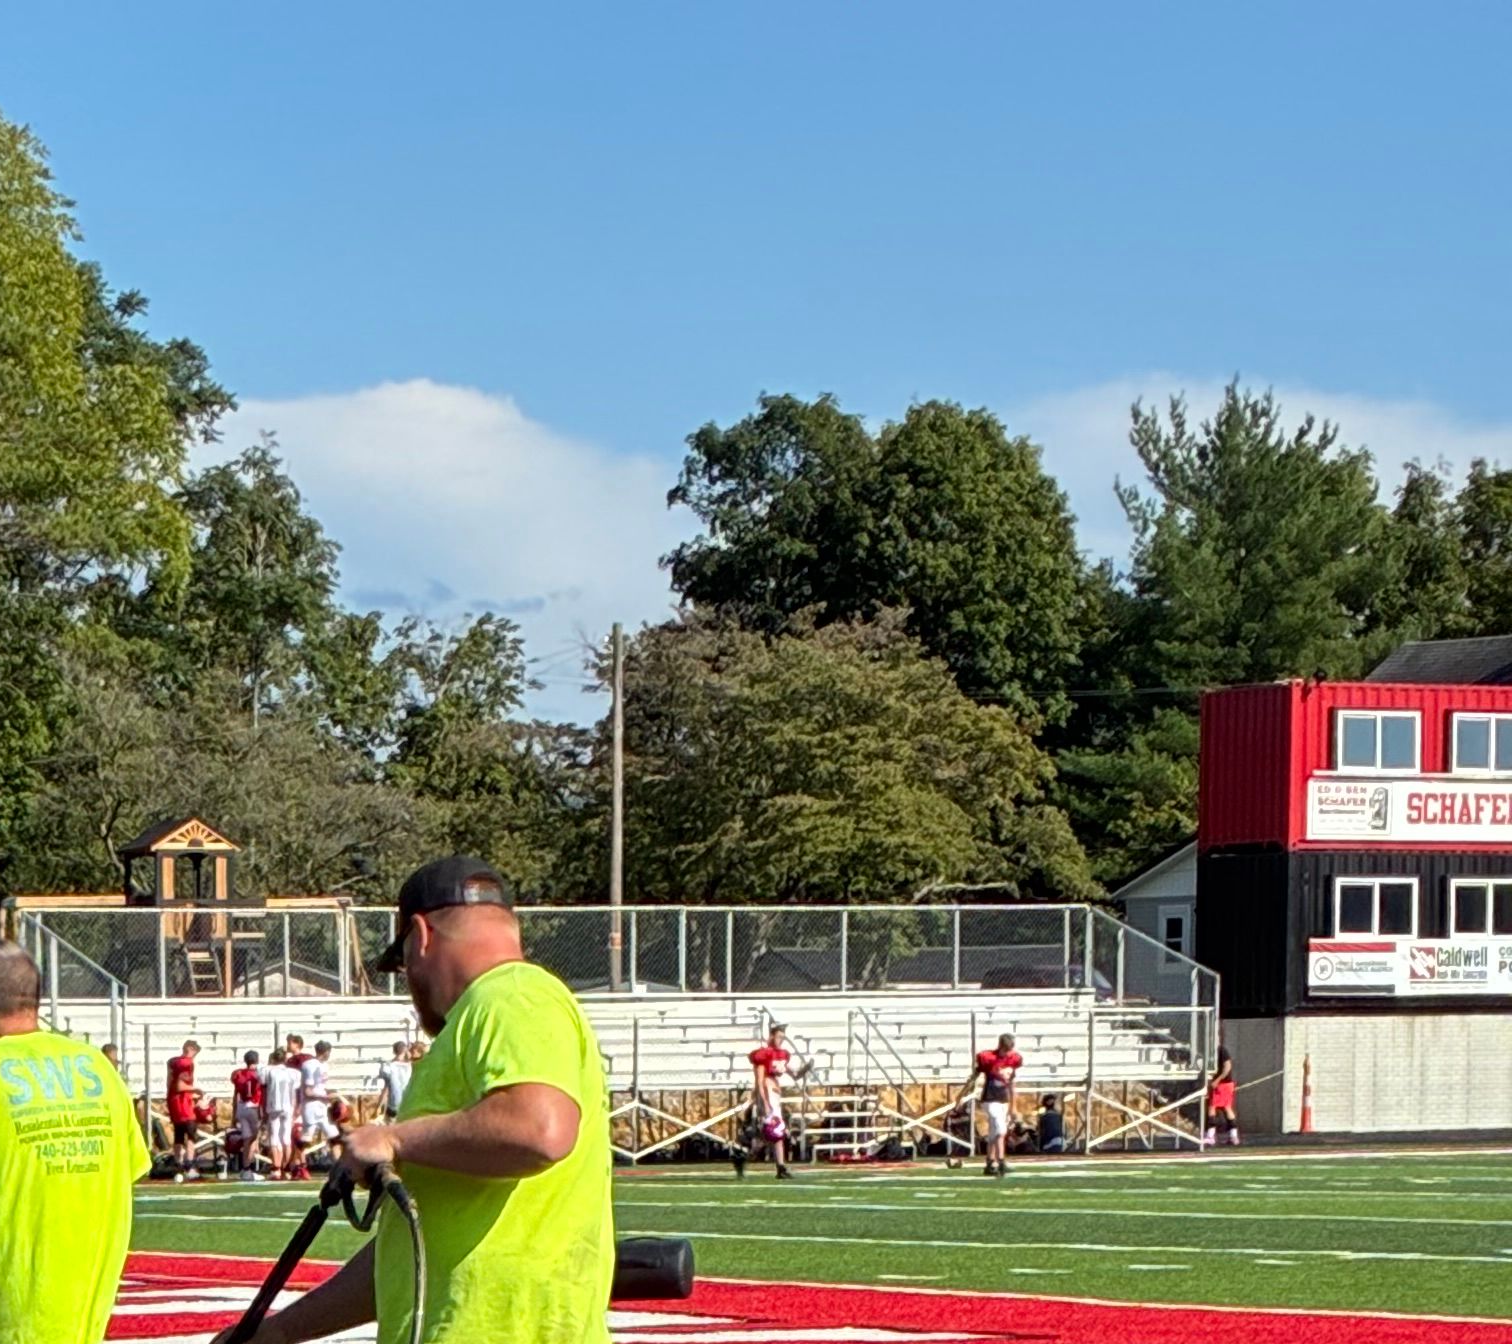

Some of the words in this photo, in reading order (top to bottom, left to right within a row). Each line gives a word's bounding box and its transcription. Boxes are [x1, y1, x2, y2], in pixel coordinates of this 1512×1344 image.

[1406, 792, 1512, 825] SCHAFE
[1436, 946, 1488, 967] Caldwell
[0, 1054, 104, 1105] SWS
